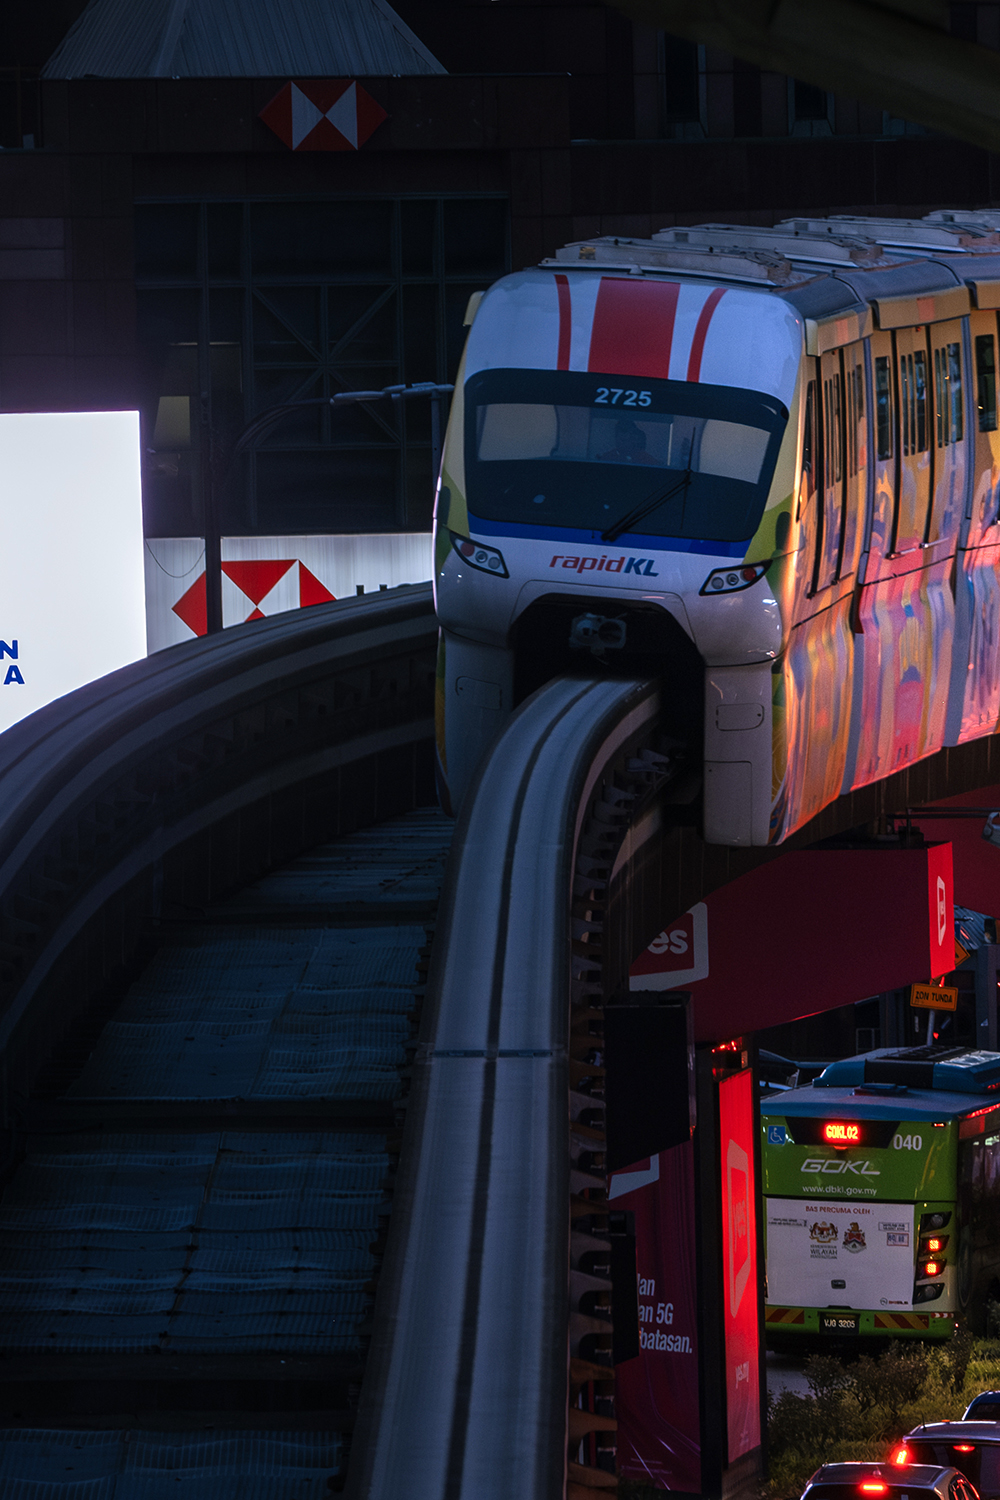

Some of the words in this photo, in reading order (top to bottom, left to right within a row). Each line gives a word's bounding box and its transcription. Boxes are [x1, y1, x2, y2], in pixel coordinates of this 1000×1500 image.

[594, 387, 652, 407] 2725
[549, 555, 659, 577] rapidKL
[646, 929, 688, 954] es
[914, 990, 929, 1001] ZON
[931, 991, 953, 1004] TUNDA
[893, 1134, 923, 1151] 040
[801, 1158, 881, 1176] GOKL
[819, 1206, 852, 1214] PERCUMA
[656, 1302, 674, 1325] 5G
[838, 1318, 856, 1329] 3205
[640, 1326, 693, 1354] batasan.
